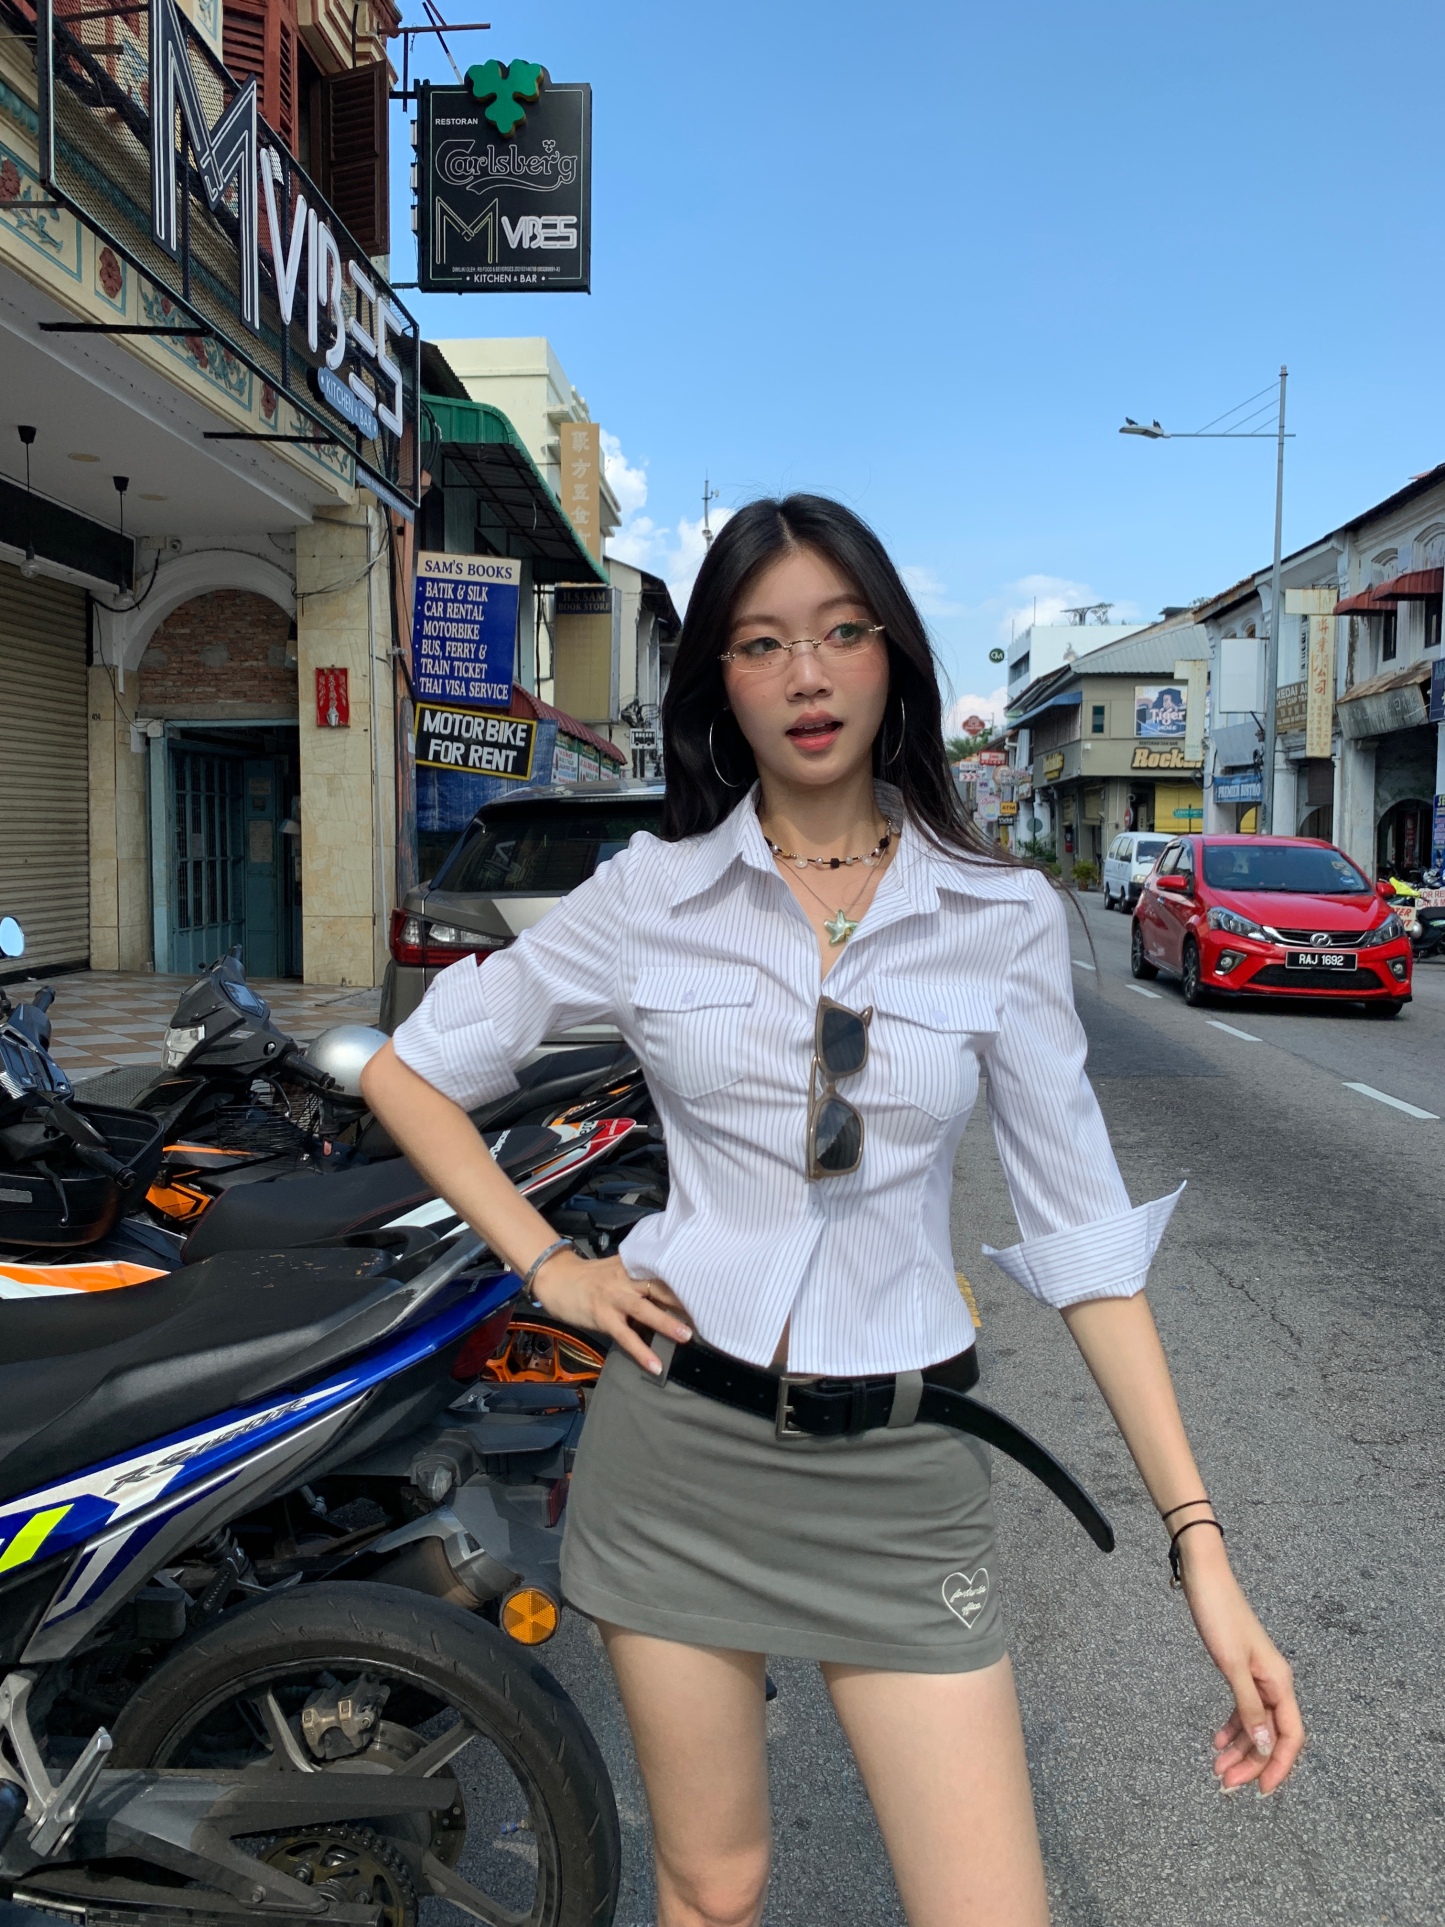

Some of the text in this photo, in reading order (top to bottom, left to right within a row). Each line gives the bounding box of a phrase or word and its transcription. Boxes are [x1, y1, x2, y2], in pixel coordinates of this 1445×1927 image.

[435, 117, 478, 126] RESTORAN
[435, 139, 578, 188] Carlsberg
[435, 195, 578, 265] M VIBES
[473, 274, 511, 283] KITCHEN
[520, 274, 537, 283] BAR
[325, 375, 354, 417] KITCHEN
[359, 408, 372, 433] BAR
[424, 560, 513, 579] SAM'S BOOKS
[425, 581, 488, 602] BATIK & SILK
[424, 601, 485, 621] CAR RENTAL
[583, 602, 611, 611] STORE
[422, 619, 480, 640] MOTORBIKE
[421, 639, 488, 660] BUS, FERRY &
[420, 658, 488, 679] TRAIN TICKET
[419, 677, 509, 700] THAI VISA SERVICE
[1276, 684, 1298, 701] KEDAI
[1150, 708, 1185, 725] Tiger
[428, 738, 518, 773] FOR RENT
[1218, 783, 1261, 798] PREMIER BISTRO
[1299, 954, 1344, 966] RAJ 1692
